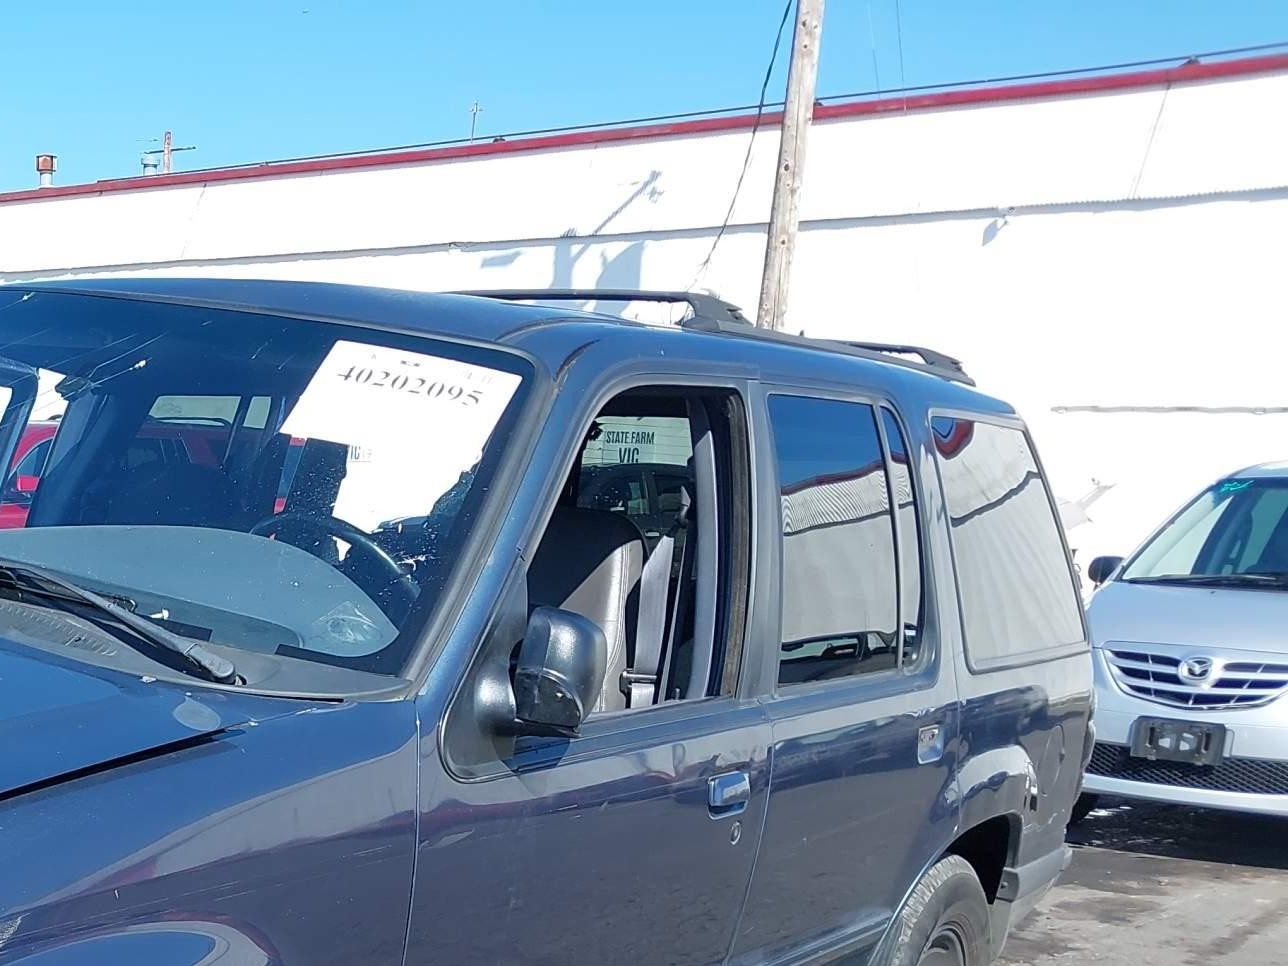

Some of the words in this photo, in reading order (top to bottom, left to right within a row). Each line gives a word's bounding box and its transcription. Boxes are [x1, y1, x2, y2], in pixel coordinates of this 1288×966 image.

[337, 366, 483, 406] 40202095
[606, 431, 630, 444] STATE
[632, 431, 655, 445] FARM
[618, 448, 640, 464] VIC
